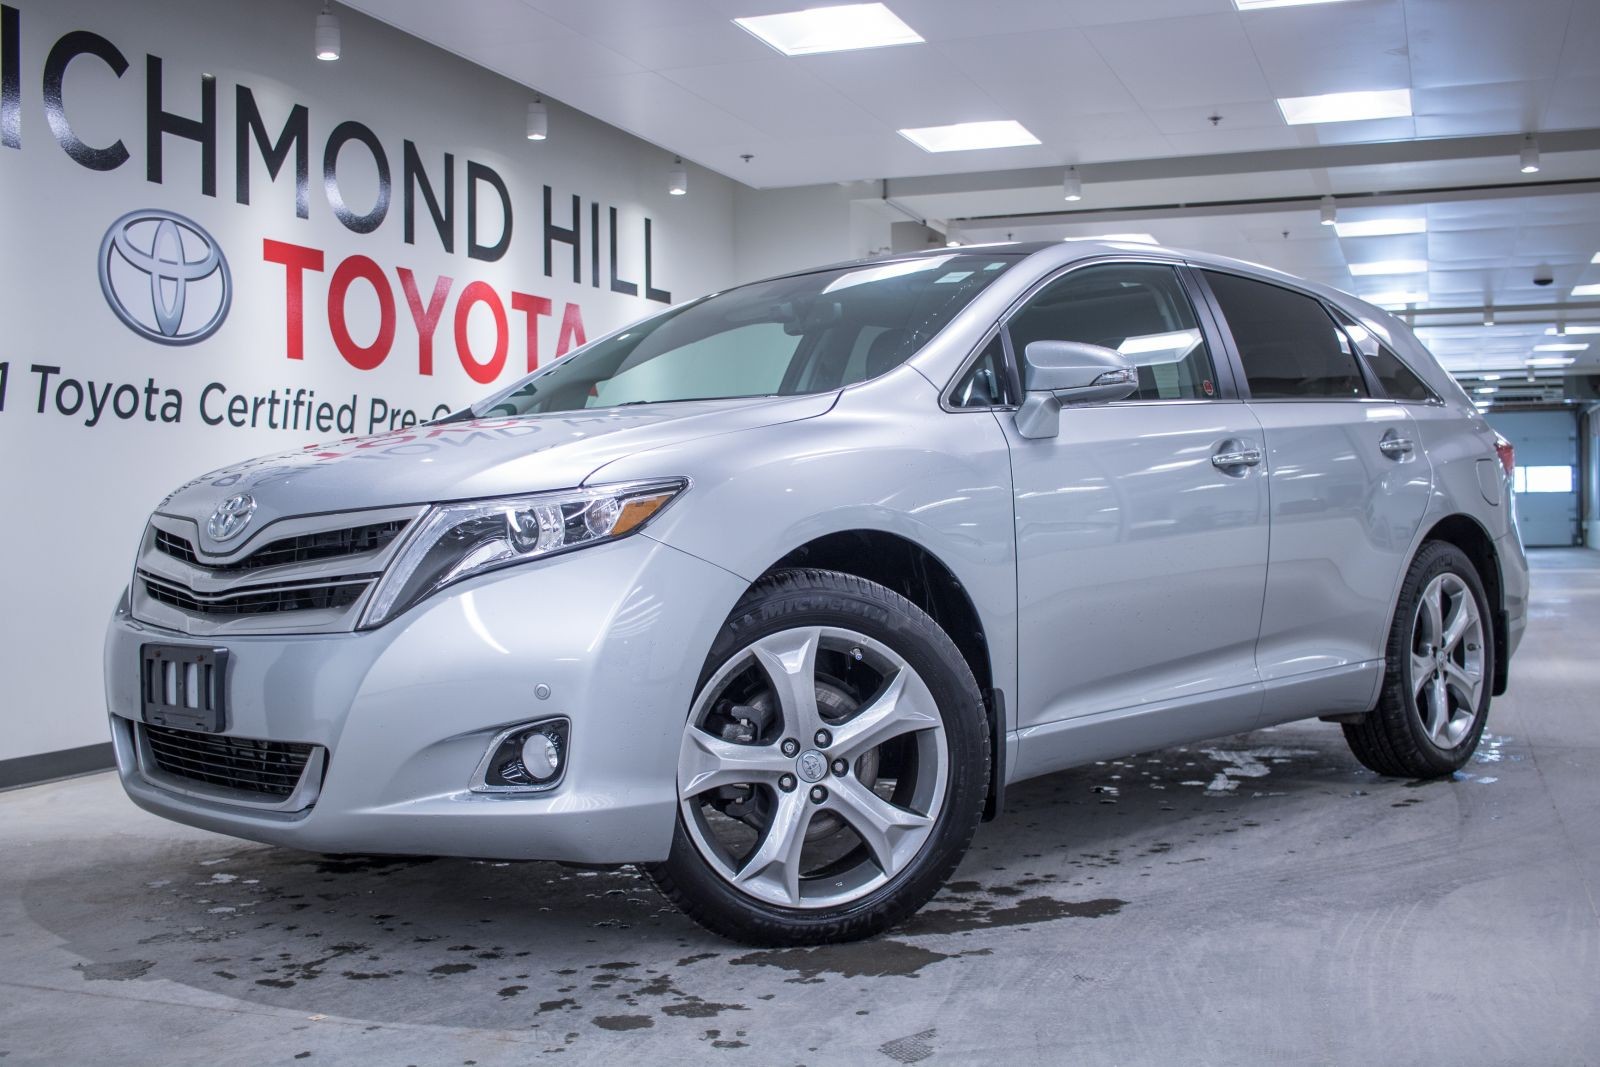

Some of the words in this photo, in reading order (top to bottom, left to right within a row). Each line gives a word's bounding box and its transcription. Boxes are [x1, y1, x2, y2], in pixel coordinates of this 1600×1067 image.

[543, 185, 671, 305] HILL
[30, 363, 183, 428] Toyota
[199, 382, 357, 434] Certified
